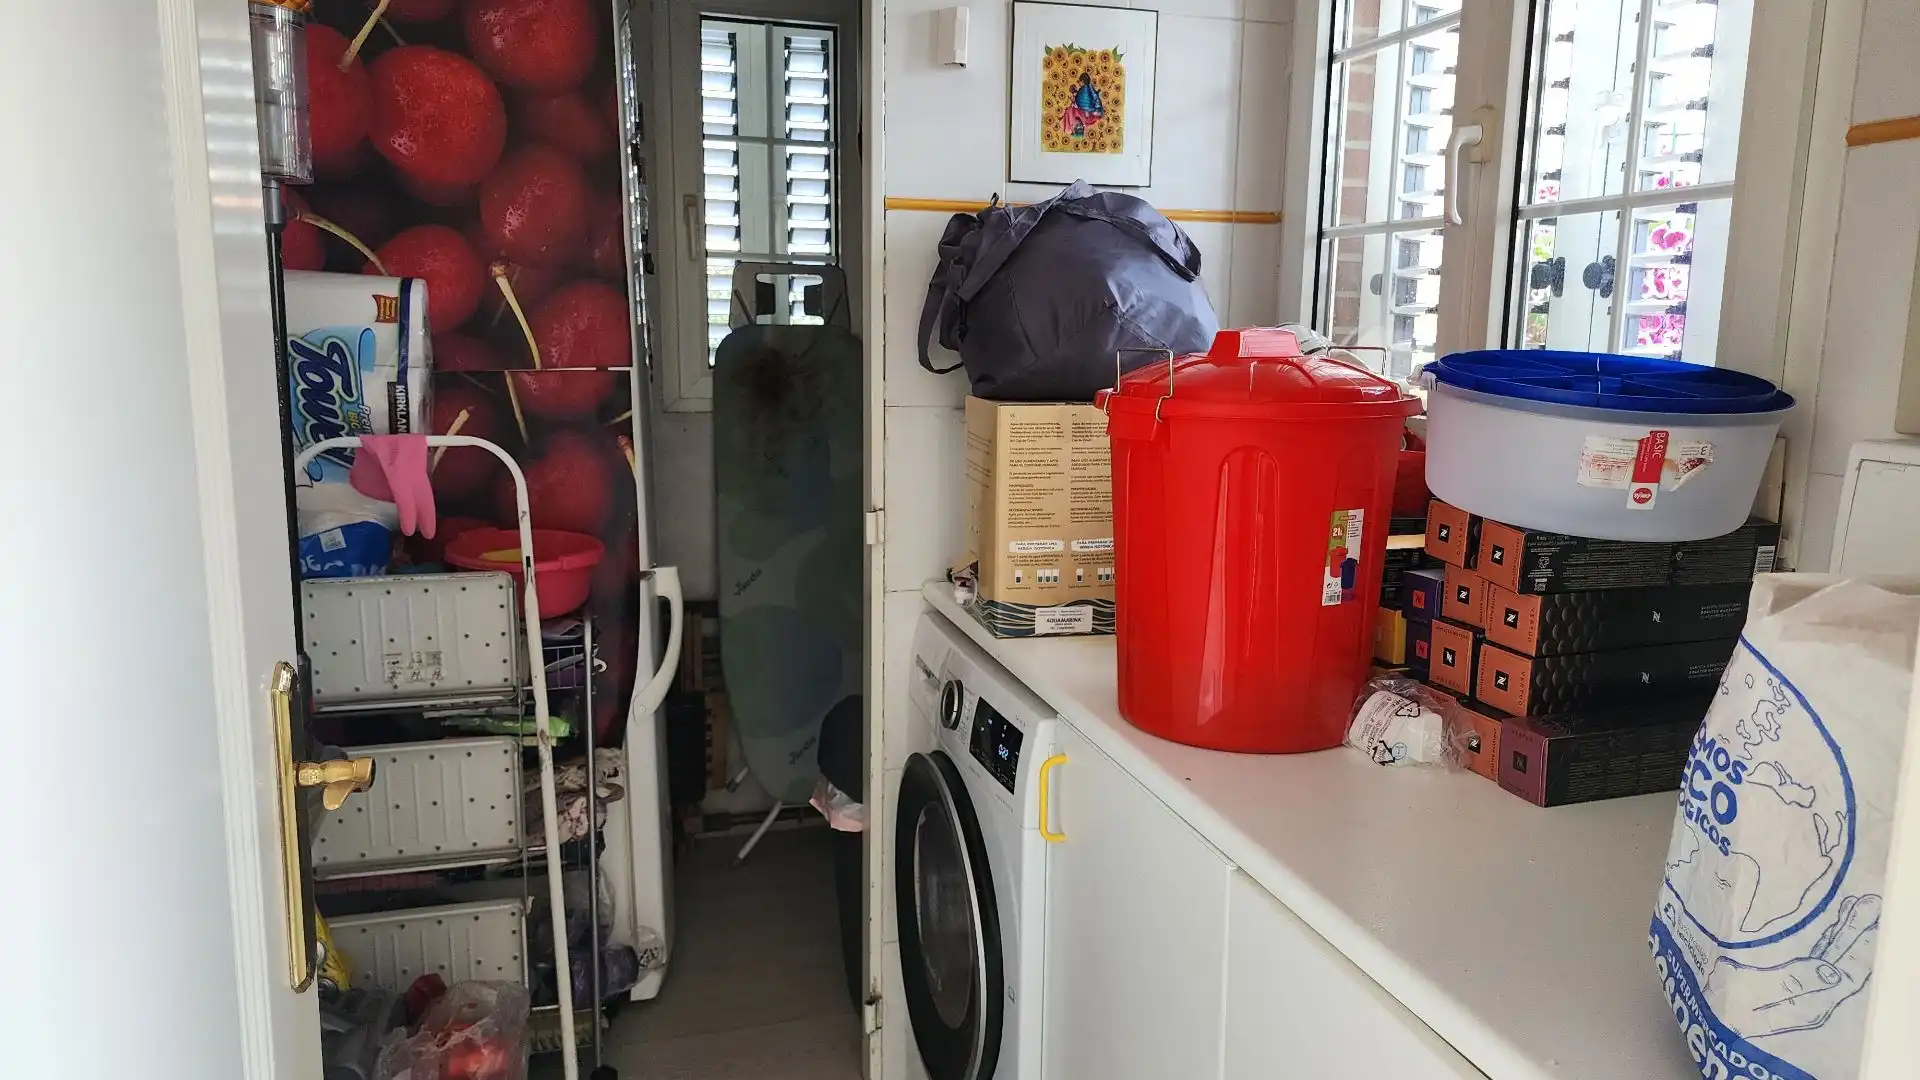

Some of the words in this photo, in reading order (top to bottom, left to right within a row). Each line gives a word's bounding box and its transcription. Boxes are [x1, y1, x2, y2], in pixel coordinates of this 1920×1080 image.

[396, 384, 408, 433] KIRKLAN
[1651, 432, 1666, 459] BASIC
[1518, 671, 1527, 706] VERTUO
[1697, 721, 1749, 785] OMOS
[1678, 787, 1732, 857] OGICOS
